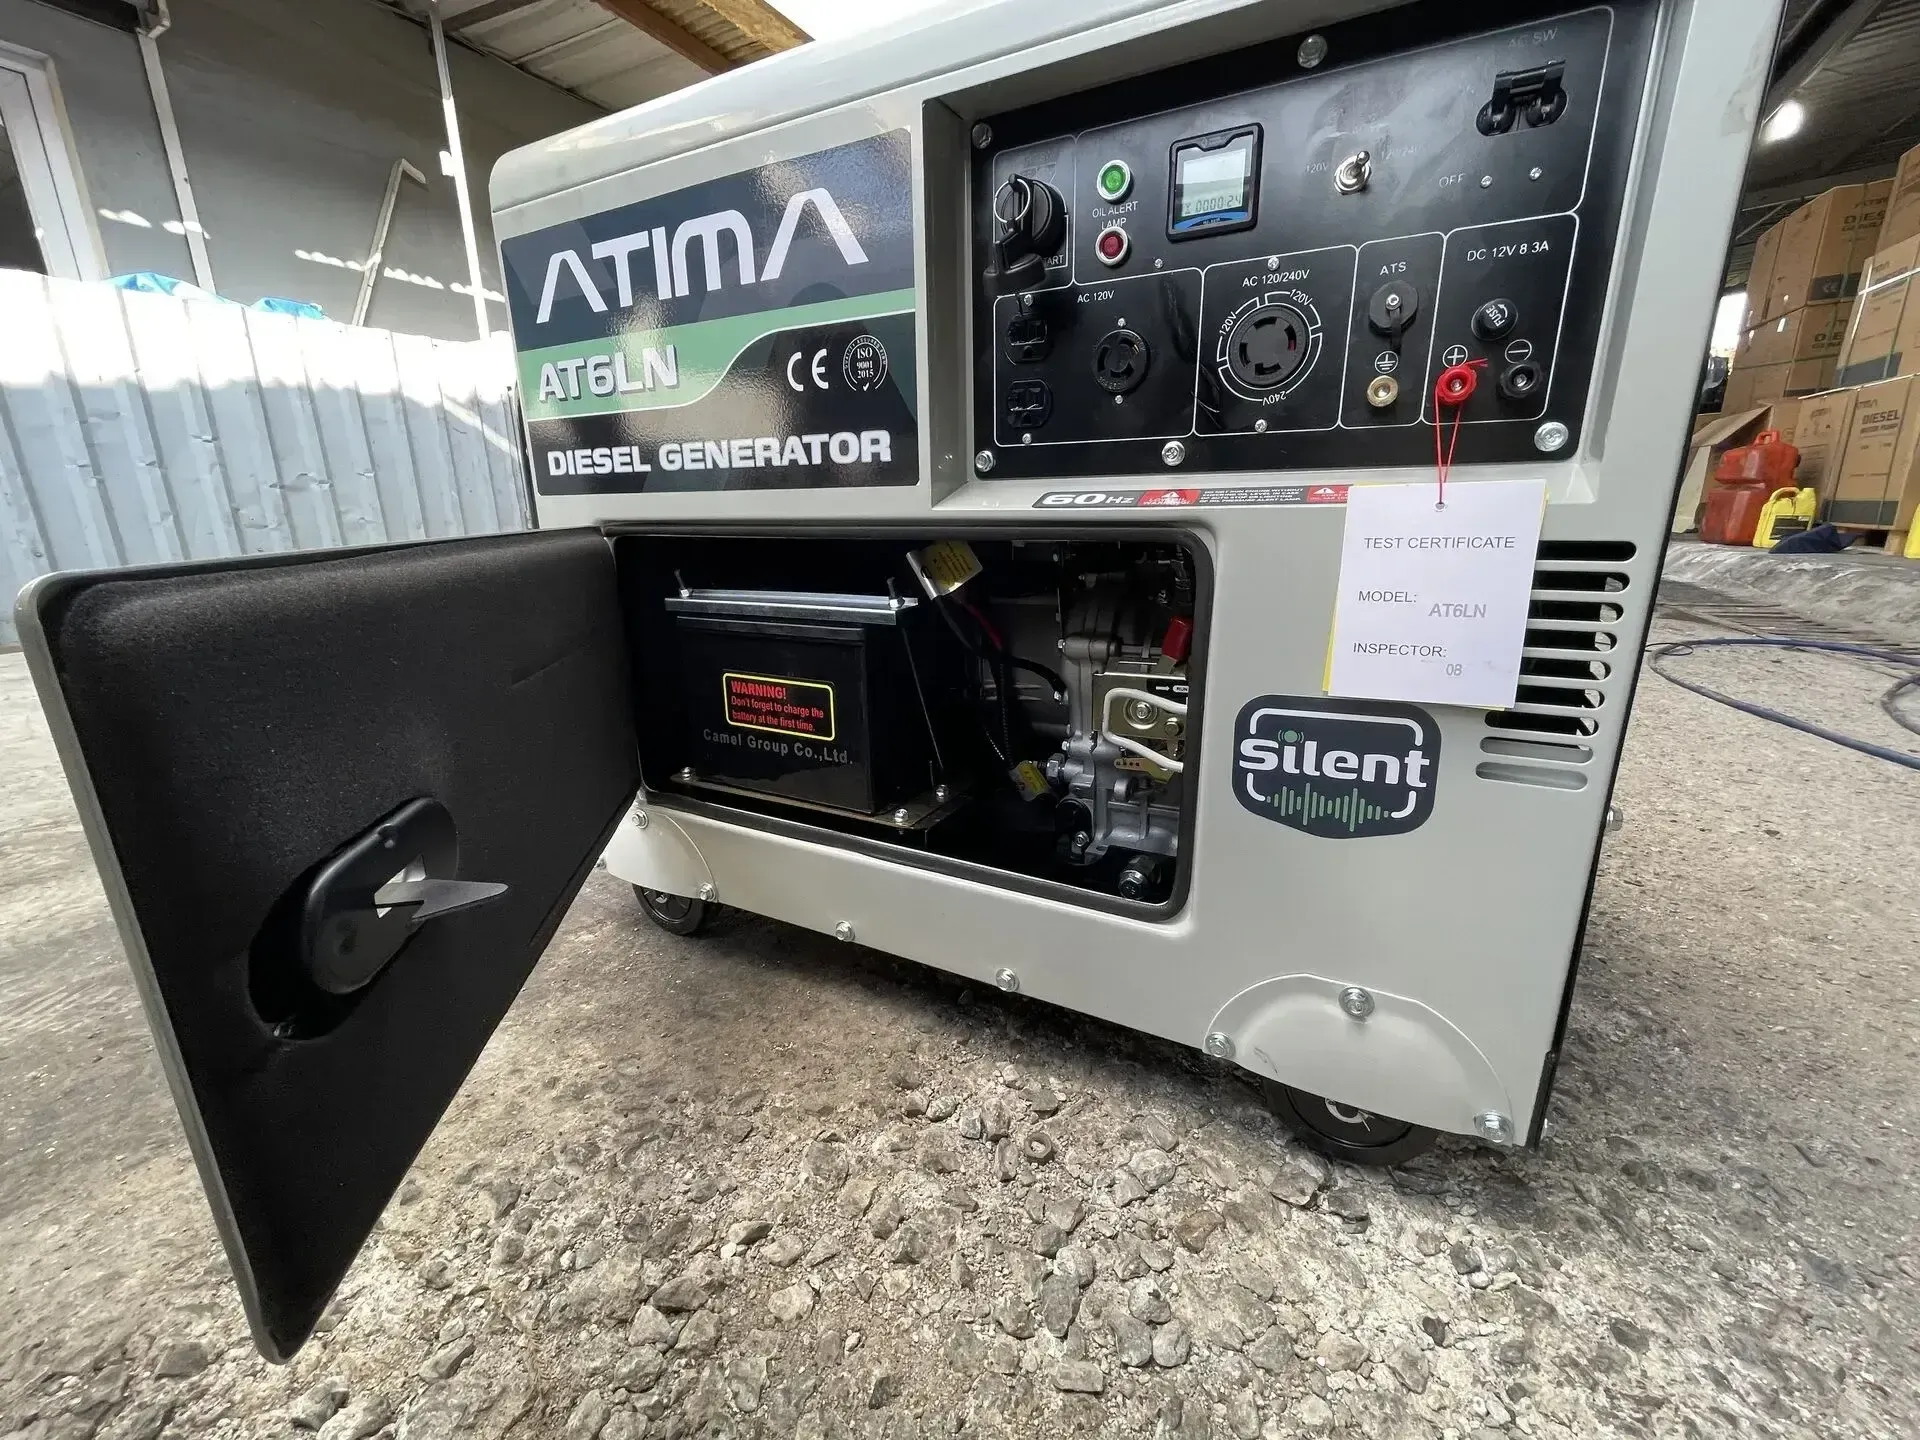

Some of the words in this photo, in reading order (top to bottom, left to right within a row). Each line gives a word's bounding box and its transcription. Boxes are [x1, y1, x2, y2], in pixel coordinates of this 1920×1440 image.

[1439, 173, 1466, 188] OFF
[1092, 206, 1106, 218] OIL
[1108, 201, 1139, 216] ALERT
[1101, 217, 1127, 230] LAMP
[536, 188, 869, 324] ATIMA
[1043, 254, 1064, 267] TART
[1467, 249, 1487, 261] DC
[1492, 244, 1517, 258] 12V
[1379, 261, 1407, 276] ATS
[1242, 276, 1258, 288] AC
[1261, 269, 1310, 284] 120/240V
[1077, 292, 1092, 304] AC
[1095, 290, 1116, 302] 120V
[1289, 288, 1313, 306] 120V
[1219, 311, 1238, 335] 120V
[1485, 304, 1506, 328] FUSE
[857, 347, 873, 359] ISO
[538, 344, 679, 402] AT6LN
[786, 348, 829, 392] CE
[856, 360, 873, 370] 9001
[857, 369, 874, 379] 2015
[1262, 390, 1287, 406] 240V
[1862, 409, 1900, 424] DIESEL
[547, 445, 652, 476] DIESEL
[659, 429, 892, 470] GENERATOR
[1364, 537, 1404, 549] TEST
[1407, 536, 1516, 549] CERTIFICATE
[1358, 590, 1417, 603] MODEL:
[1428, 603, 1487, 618] AT6LN
[1353, 642, 1447, 658] INSPECTOR:
[1445, 663, 1463, 676] 08
[730, 680, 787, 700] WARNING!
[731, 695, 750, 707] Don't
[752, 699, 773, 712] forget
[774, 701, 782, 711] to
[783, 704, 810, 718] charge
[811, 707, 824, 719] the
[732, 709, 757, 725] battery
[758, 714, 766, 724] at
[766, 714, 778, 726] the
[780, 716, 795, 729] first
[796, 719, 816, 732] time.
[703, 728, 742, 746] Camel
[747, 735, 789, 757] Group
